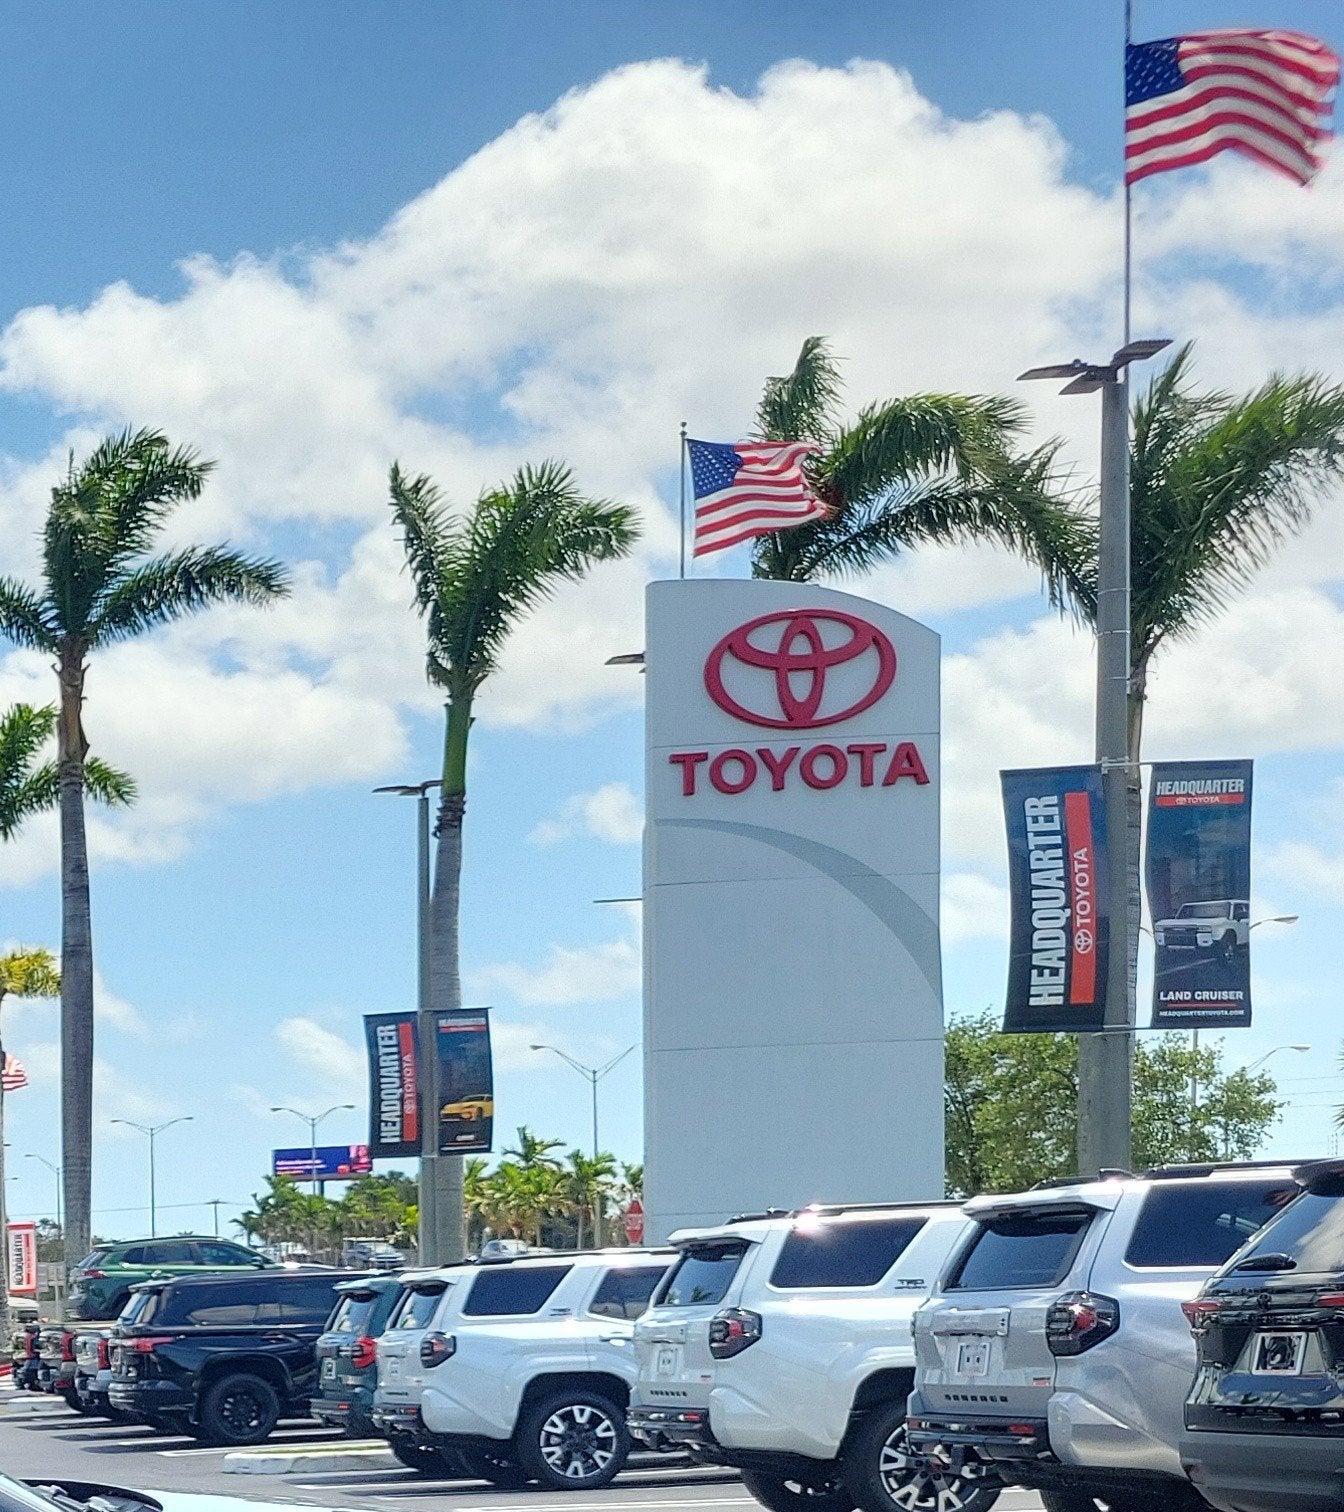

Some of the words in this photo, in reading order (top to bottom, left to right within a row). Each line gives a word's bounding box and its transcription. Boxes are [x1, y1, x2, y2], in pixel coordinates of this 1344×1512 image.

[670, 741, 931, 797] TOYOTA
[1156, 778, 1244, 796] HEADQUARTER
[1186, 796, 1220, 804] TOYOTA
[1023, 795, 1071, 1007] HEADQUARTER
[1073, 847, 1092, 927] TOYOTA
[1159, 991, 1192, 1001] LAND
[1194, 991, 1244, 1001] CRUISER
[376, 1024, 402, 1144] HEADQUARTER
[402, 1053, 416, 1100] TOYOTA
